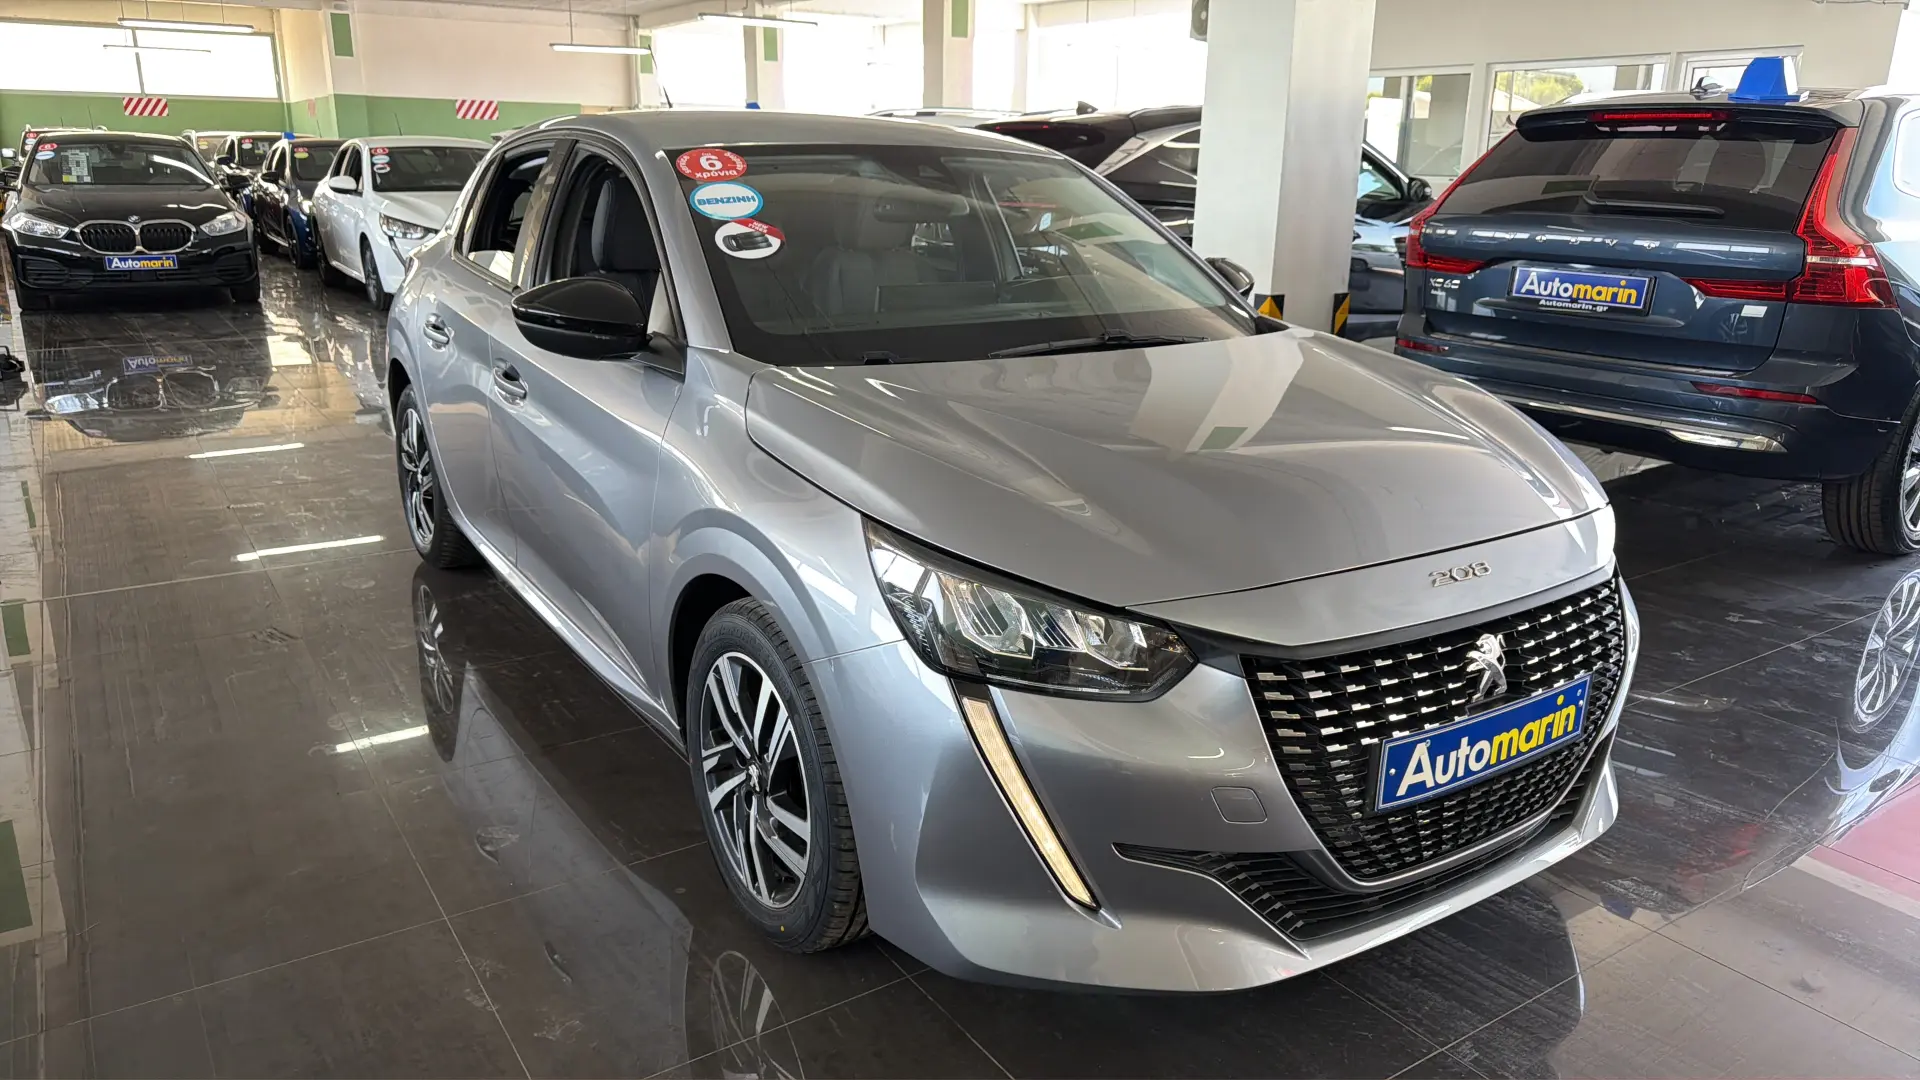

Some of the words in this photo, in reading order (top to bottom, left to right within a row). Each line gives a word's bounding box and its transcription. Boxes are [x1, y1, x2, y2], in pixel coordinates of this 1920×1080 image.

[700, 155, 723, 171] 6
[695, 169, 738, 178] χρόνια
[110, 256, 174, 268] Automarin
[1520, 272, 1638, 304] Automarin
[1539, 299, 1608, 312] Automarin.gr
[1428, 560, 1492, 587] 208
[1396, 695, 1576, 796] Automarin
